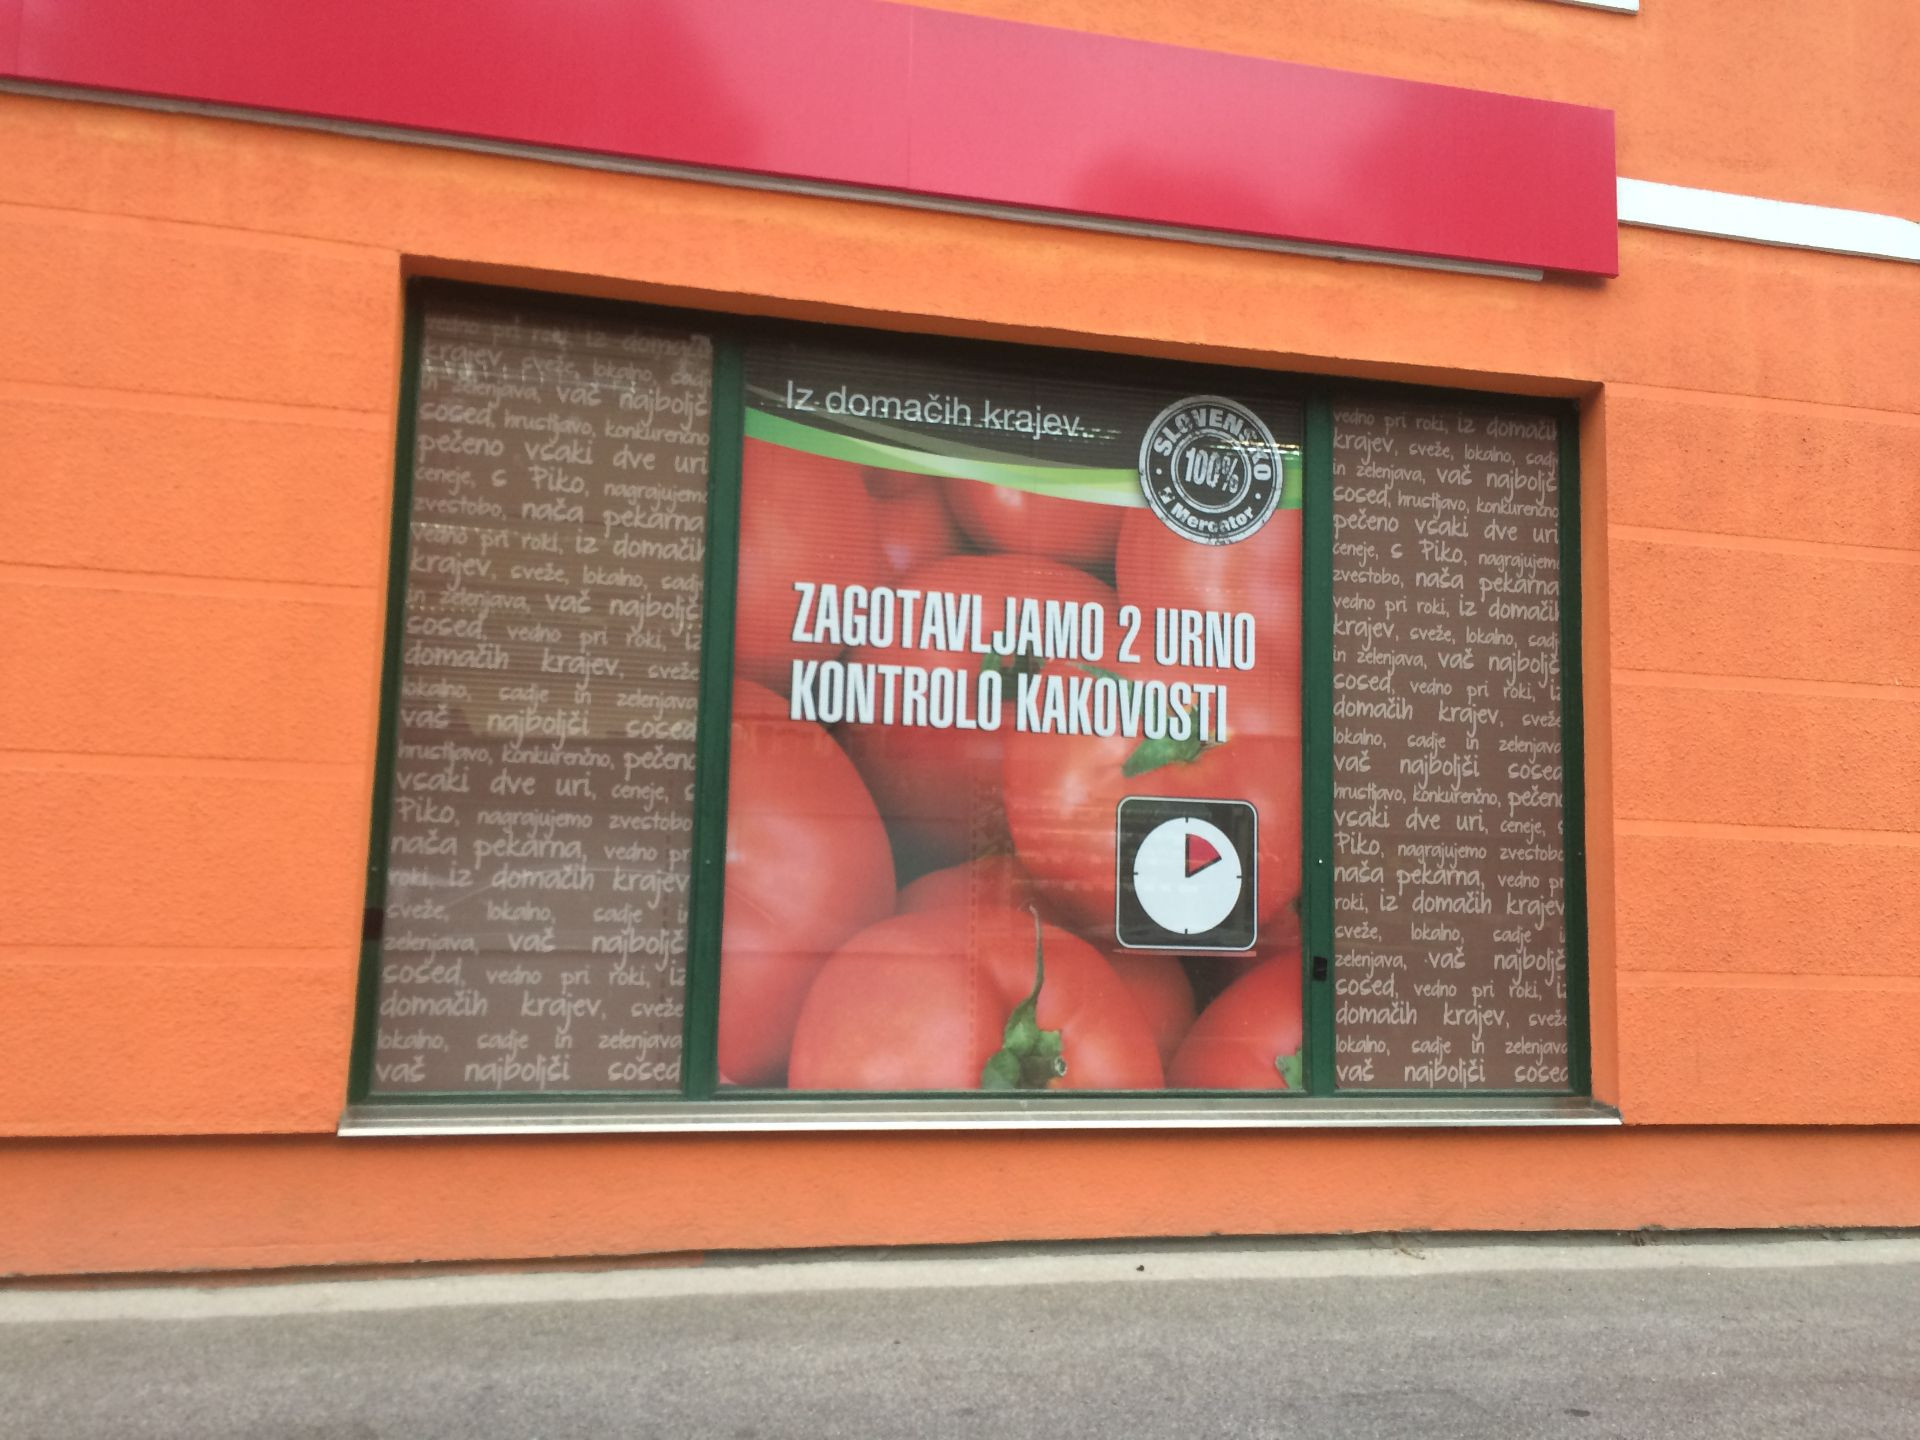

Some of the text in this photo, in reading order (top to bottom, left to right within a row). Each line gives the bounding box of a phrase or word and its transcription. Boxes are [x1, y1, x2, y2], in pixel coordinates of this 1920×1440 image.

[786, 380, 813, 411] Iz
[825, 386, 971, 427] domačih
[1185, 447, 1239, 493] 100%
[1333, 458, 1346, 475] in
[1436, 464, 1472, 485] vaš
[1171, 502, 1253, 532] Mercator
[1333, 508, 1399, 540] pečeno
[1415, 516, 1468, 537] vsaki
[1484, 519, 1517, 541] dve
[1391, 543, 1403, 559] s
[1416, 567, 1464, 589] naša
[1333, 593, 1375, 610] vedno
[1385, 600, 1407, 620] pri
[1459, 595, 1477, 616] iz
[792, 582, 1256, 671] ZAGOTAVLJAMO 2 URNO
[1333, 644, 1346, 662] in
[1438, 648, 1474, 669] vaš
[790, 659, 1228, 743] KONTROLO KAKOVOSTI
[1410, 678, 1452, 695] vedno
[1467, 681, 1489, 704] pri
[1333, 694, 1413, 720] domačih
[1407, 732, 1445, 763] sadje
[1466, 735, 1478, 750] in
[1333, 750, 1480, 790] vaš najboljši
[1334, 805, 1389, 827] vsaki
[1406, 807, 1440, 830] dve
[1398, 843, 1486, 868] nagrajujemo
[1334, 860, 1384, 883] naša
[1498, 871, 1540, 888] vedno
[1380, 890, 1398, 911] iz
[1412, 890, 1492, 914] domačih
[1493, 926, 1531, 952] sadje
[1428, 946, 1466, 969] vaš
[1414, 980, 1457, 997] vedno
[1472, 980, 1494, 1006] pri
[1336, 1000, 1417, 1025] domačih
[1412, 1037, 1450, 1063] sadje
[1472, 1038, 1484, 1053] in
[1336, 1058, 1486, 1088] vaš najboljši
